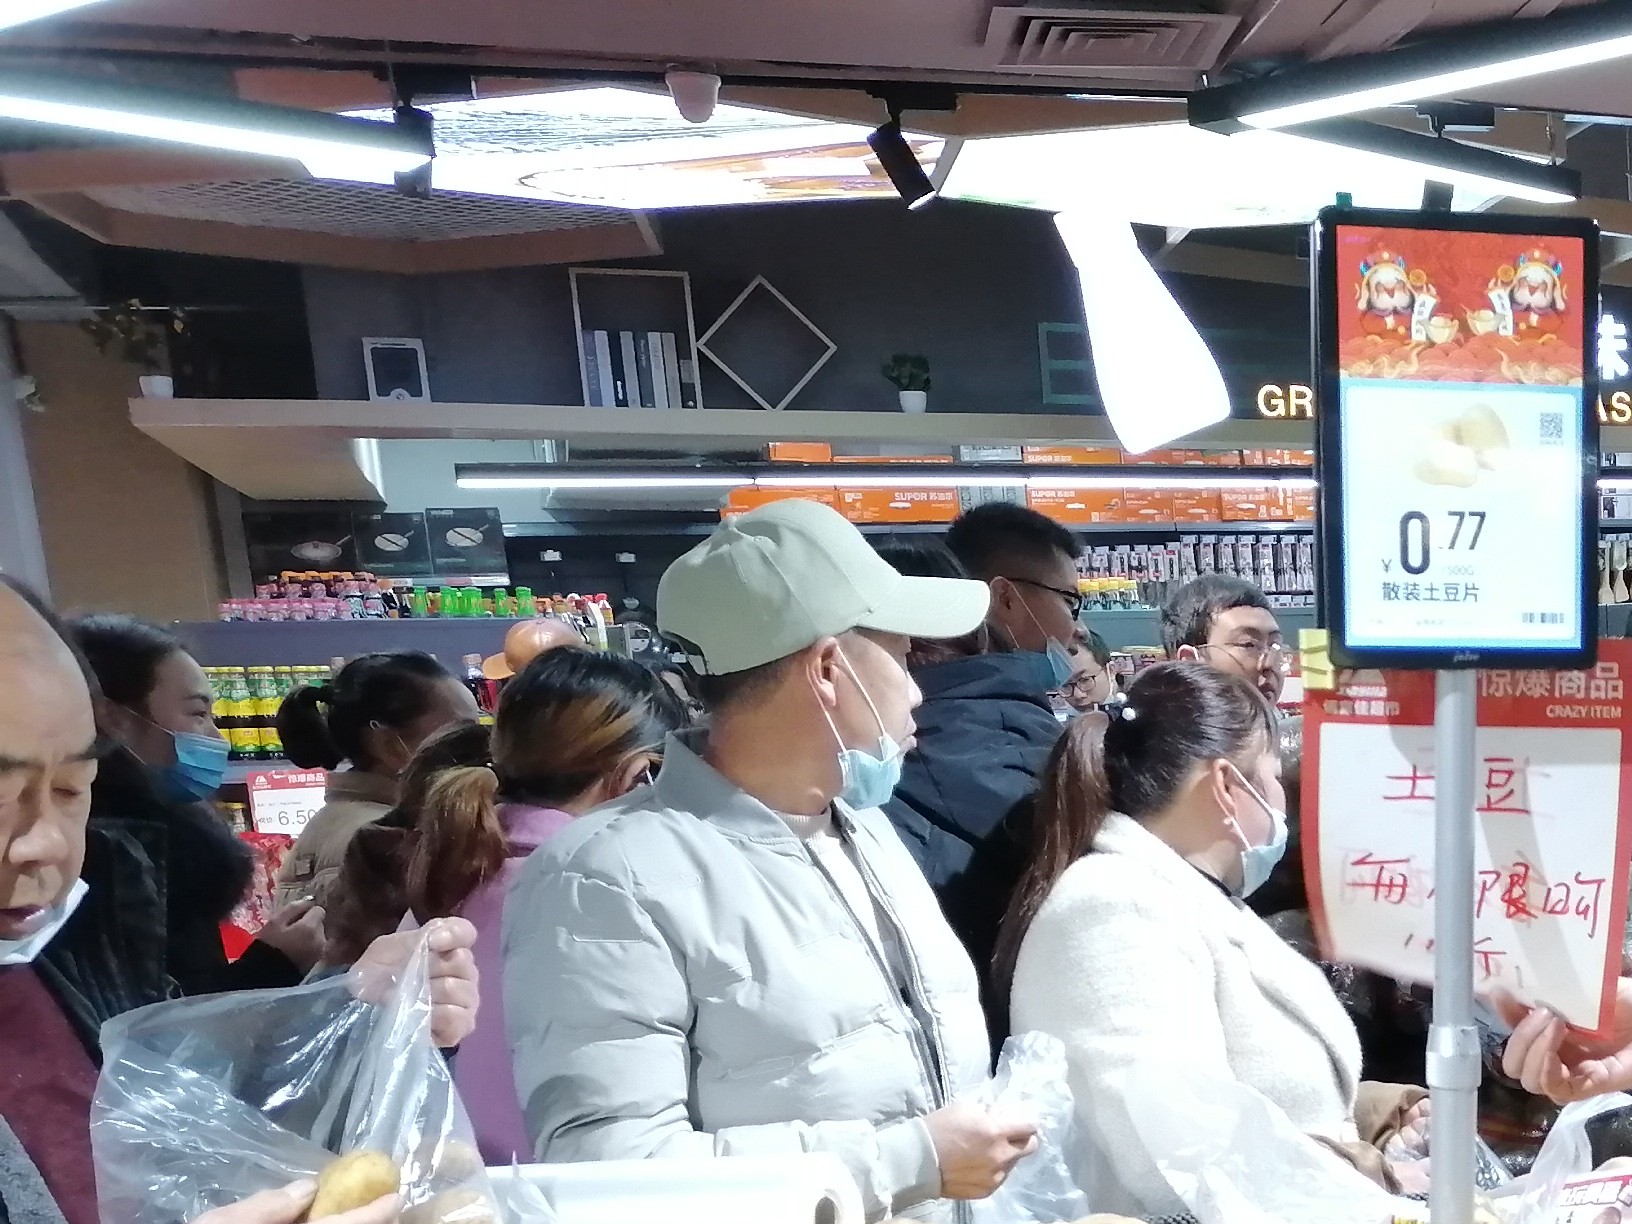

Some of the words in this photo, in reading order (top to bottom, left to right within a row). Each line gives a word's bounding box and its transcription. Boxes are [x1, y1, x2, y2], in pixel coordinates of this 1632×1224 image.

[894, 491, 928, 501] SUPOR
[1382, 582, 1480, 603] 散装土豆片
[1546, 705, 1588, 718] CRAZY
[1590, 706, 1622, 718] ITEM
